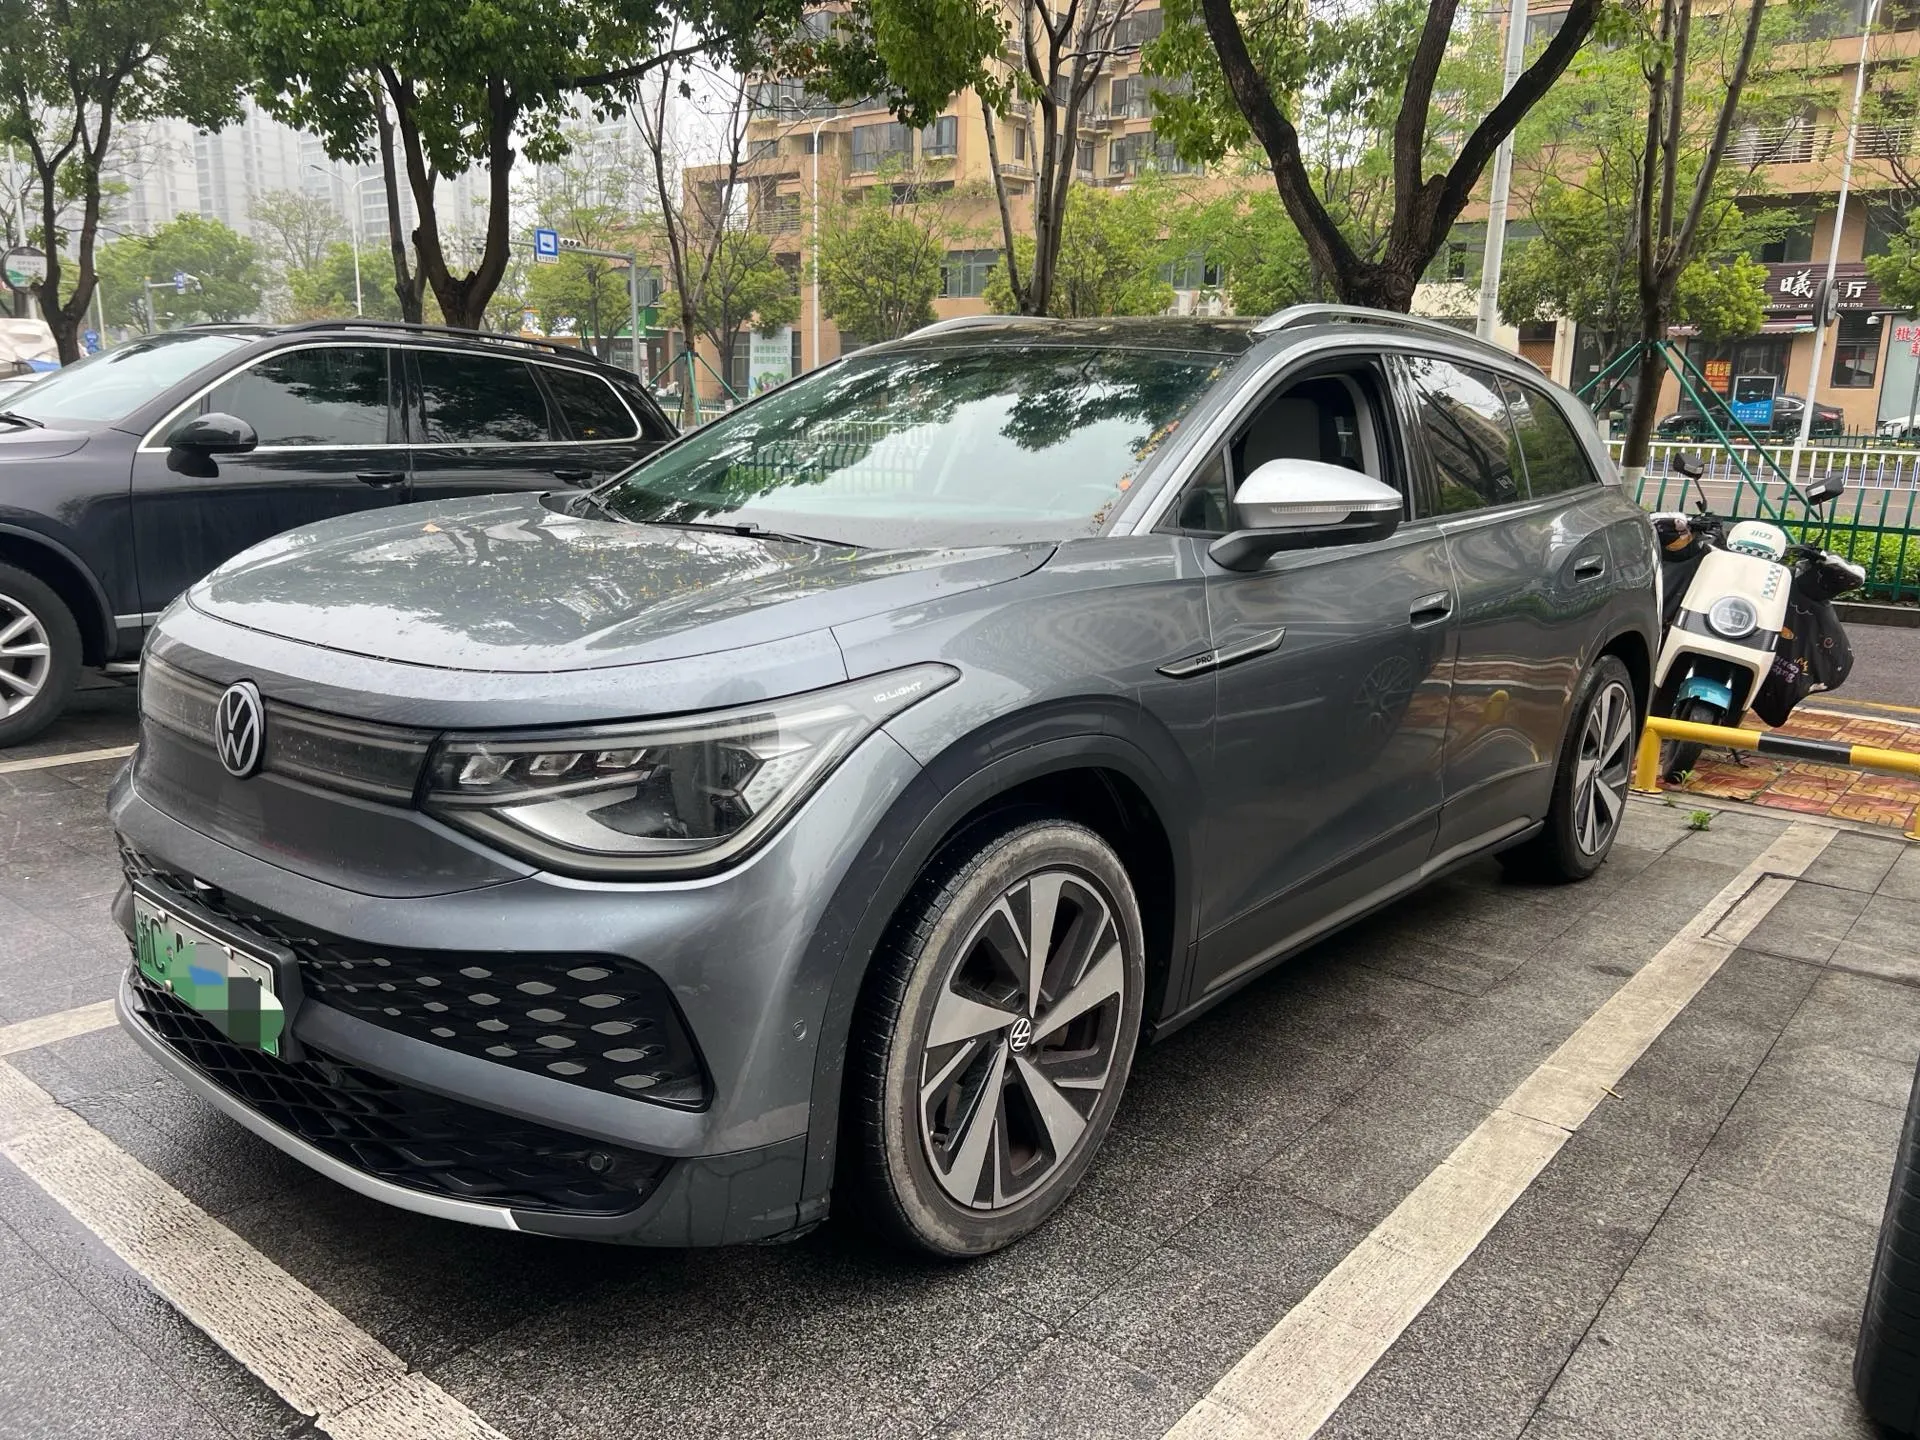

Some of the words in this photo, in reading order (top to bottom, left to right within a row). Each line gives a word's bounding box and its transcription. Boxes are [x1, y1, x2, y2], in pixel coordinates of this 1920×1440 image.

[1779, 268, 1868, 299] 曦厅
[1195, 654, 1213, 666] PRO
[873, 682, 923, 704] IQ.LIGHT
